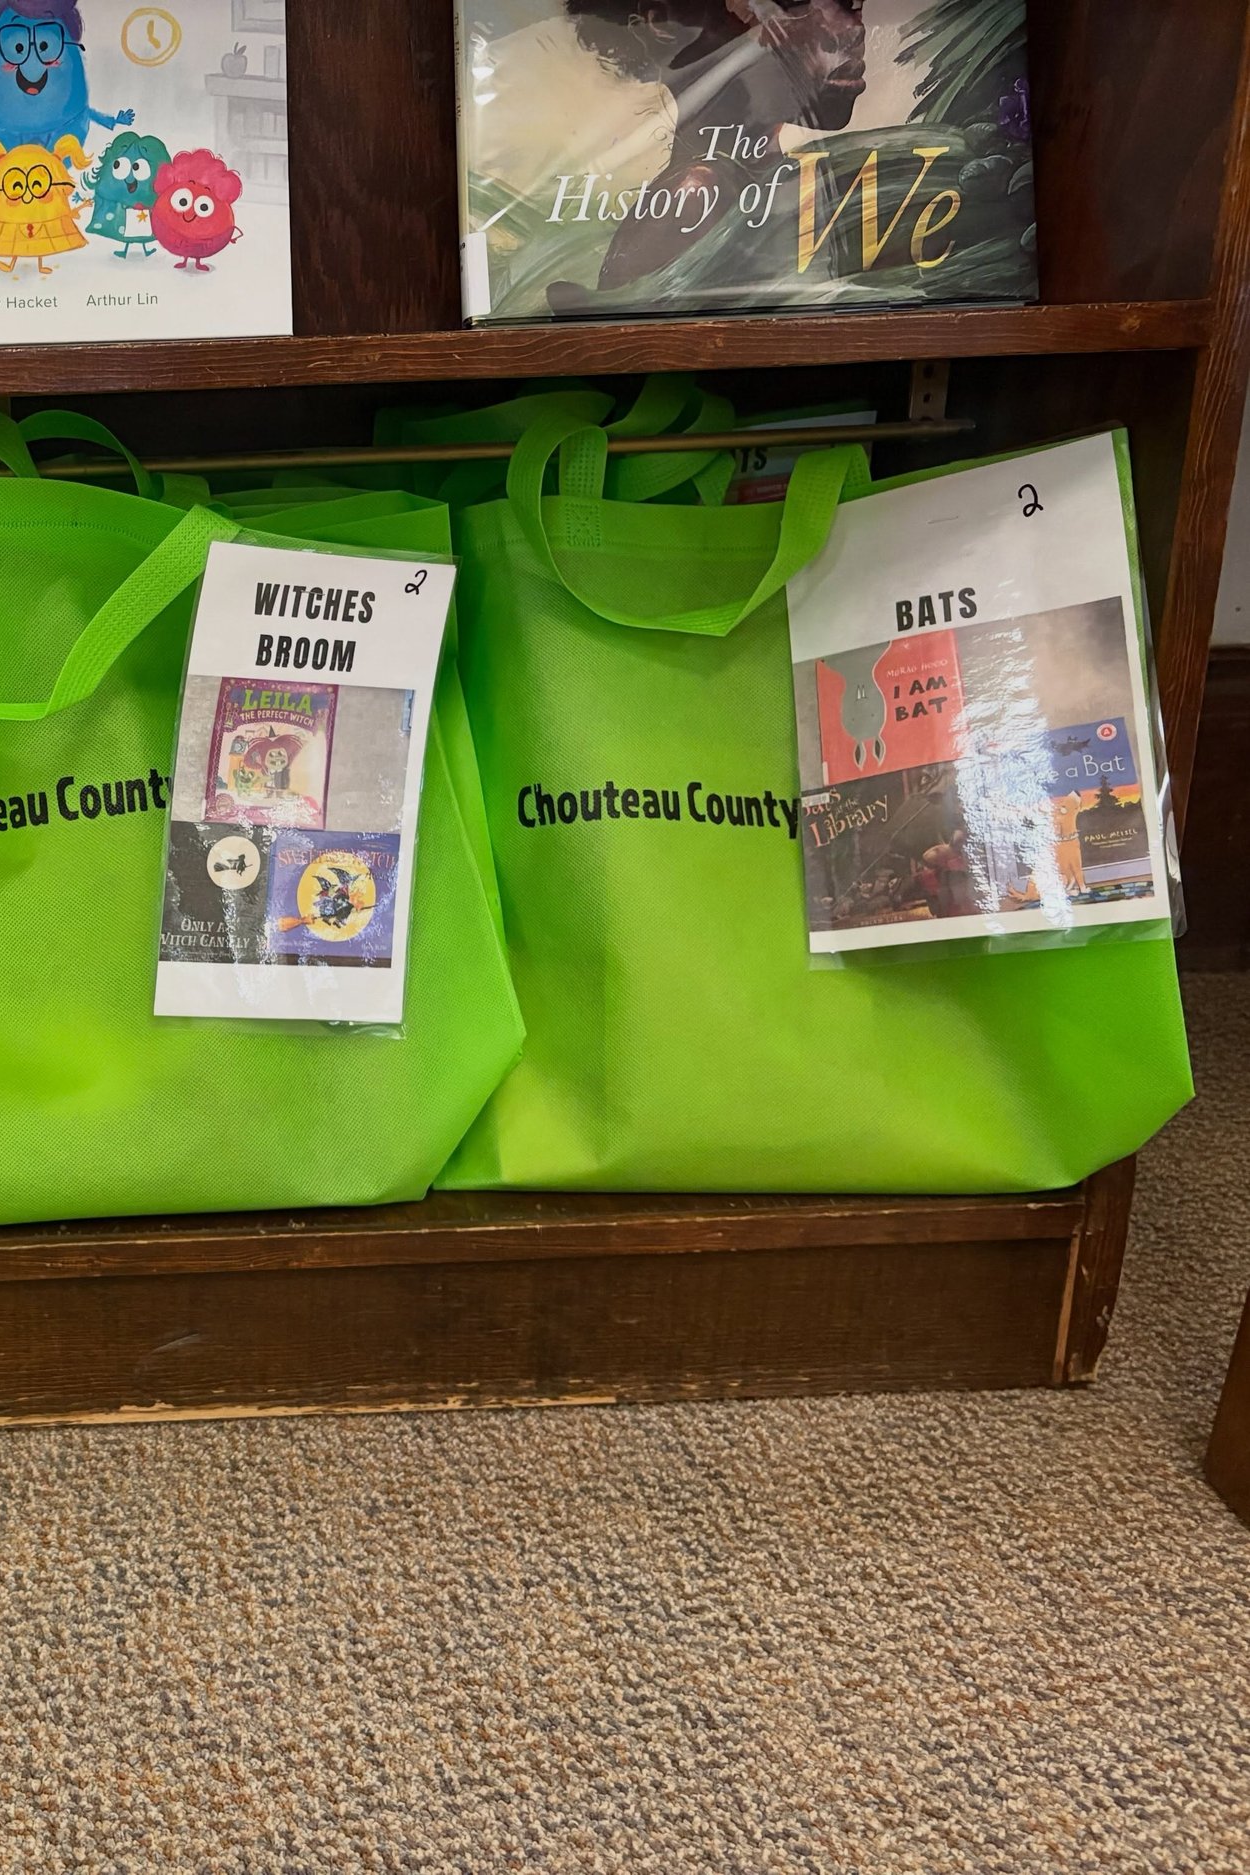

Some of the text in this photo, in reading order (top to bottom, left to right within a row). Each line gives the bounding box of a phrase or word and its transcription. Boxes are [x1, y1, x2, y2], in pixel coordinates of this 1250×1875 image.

[698, 124, 768, 163] The
[545, 146, 963, 275] History of We
[6, 296, 58, 309] Hacket
[86, 293, 158, 307] Arthur Lin
[1017, 483, 1044, 517] 2
[404, 569, 428, 595] 2
[254, 582, 376, 624] WITCHES
[896, 587, 978, 632] BATS
[255, 634, 357, 672] BROOM
[893, 675, 948, 699] I AM
[241, 689, 313, 717] LEILA
[895, 696, 948, 722] BAT
[240, 710, 315, 727] THE PERFECT WITCH
[1065, 766, 1079, 778] a
[1082, 754, 1126, 777] Bat
[518, 781, 799, 839] Chouteau County
[809, 794, 888, 848] Library
[1084, 833, 1107, 842] PAUL
